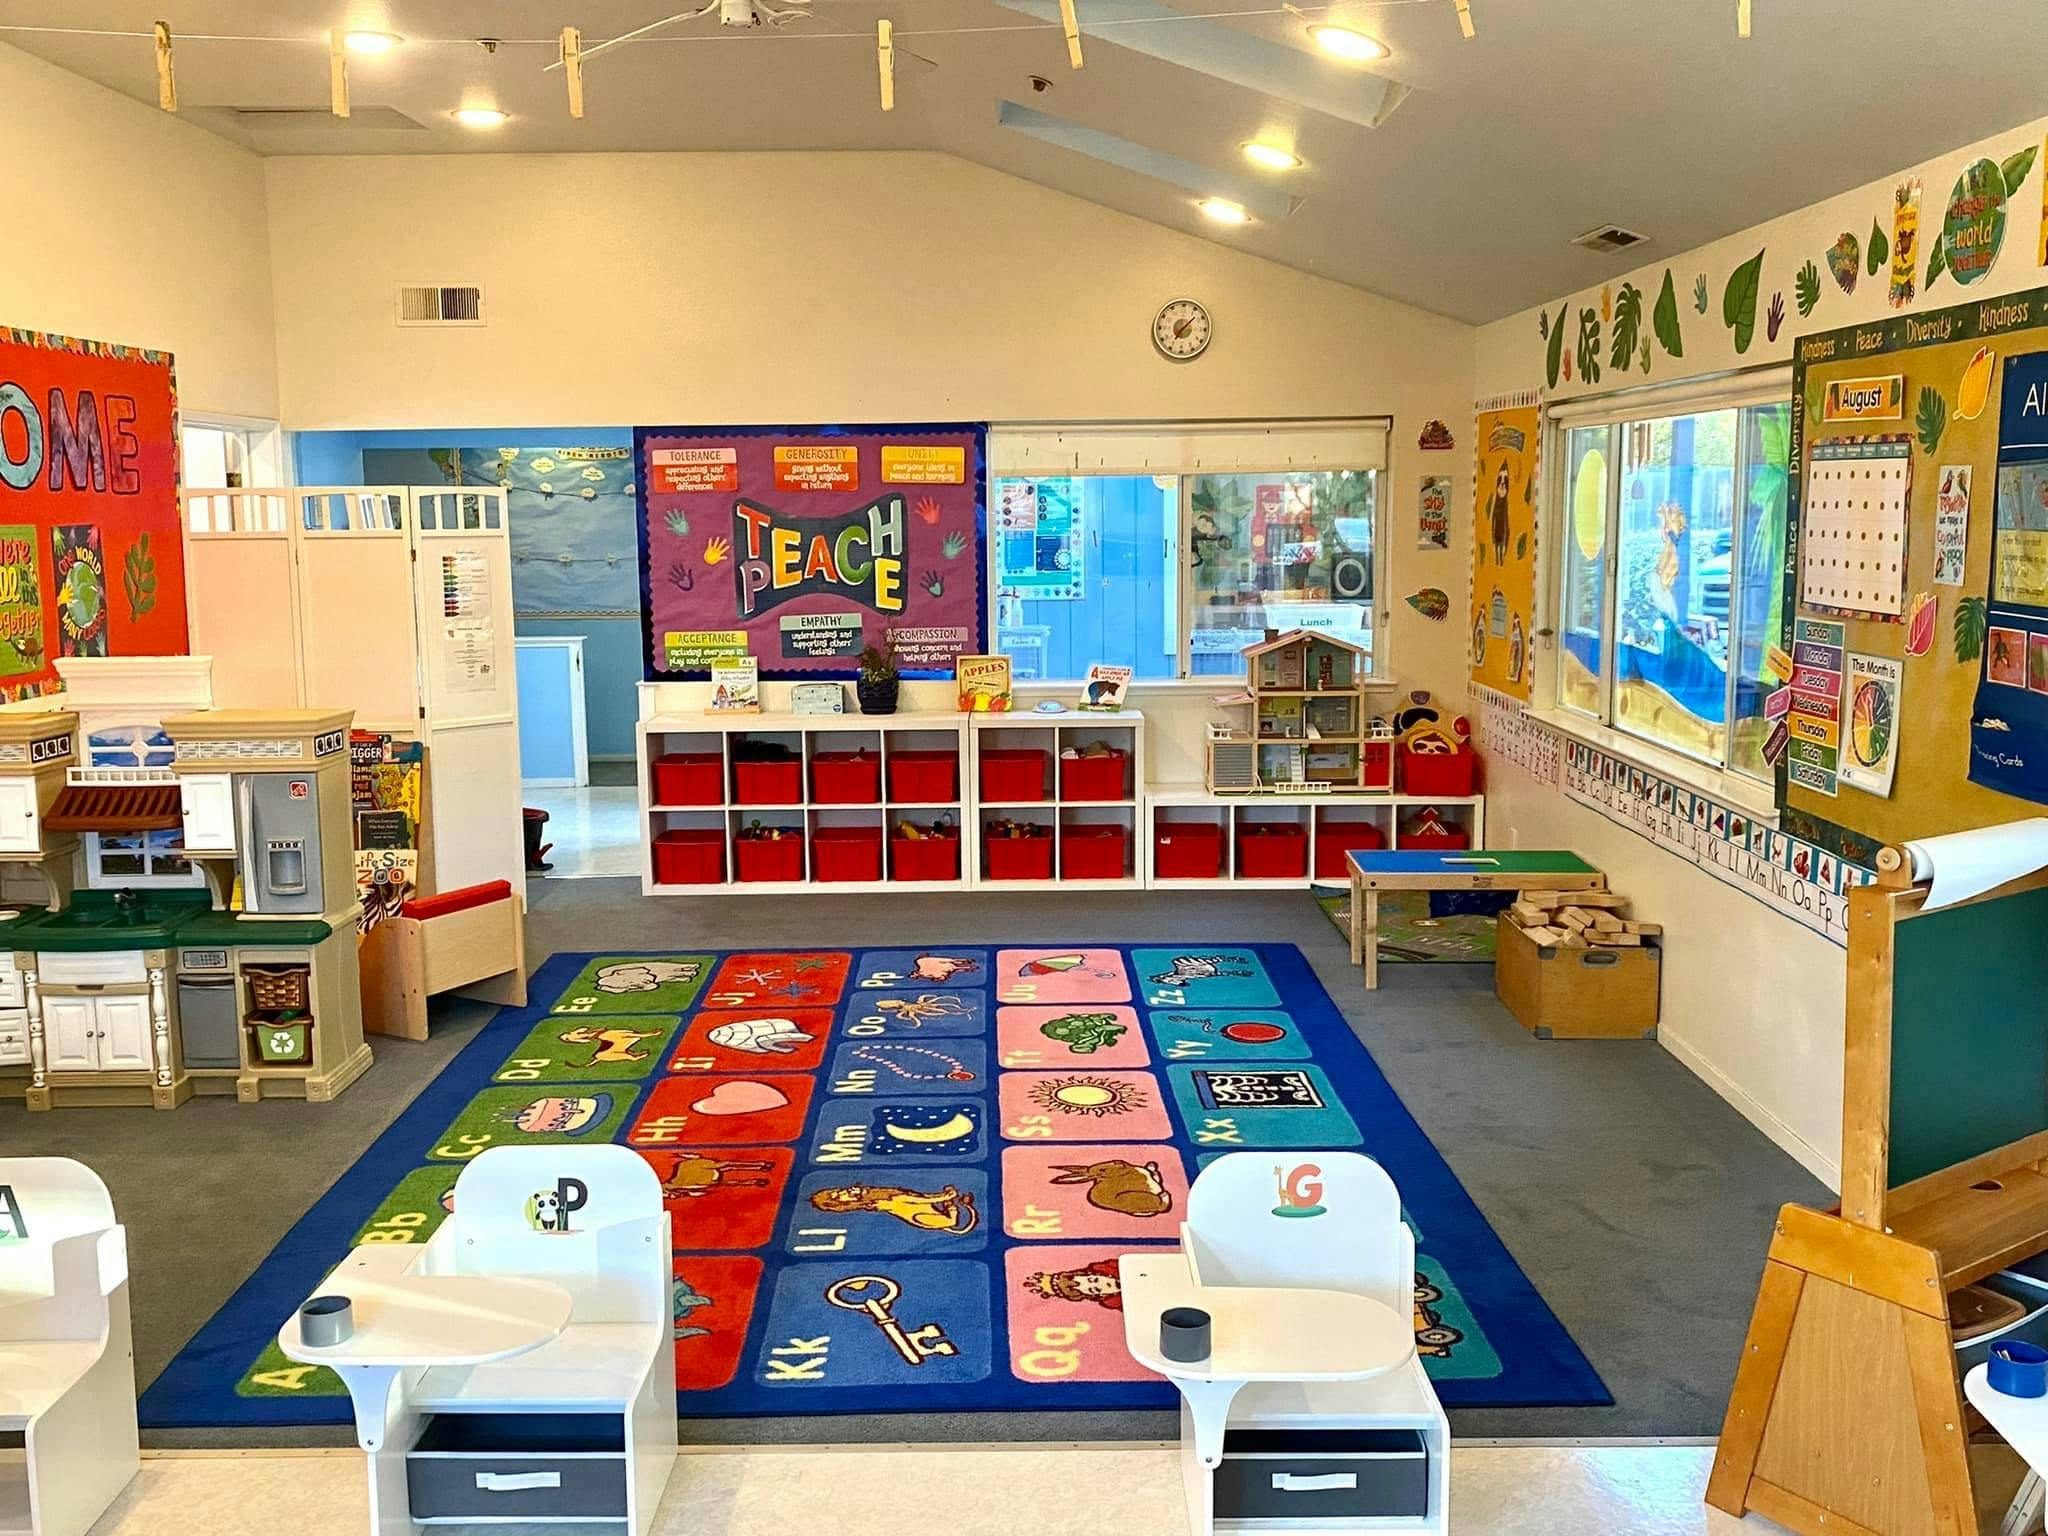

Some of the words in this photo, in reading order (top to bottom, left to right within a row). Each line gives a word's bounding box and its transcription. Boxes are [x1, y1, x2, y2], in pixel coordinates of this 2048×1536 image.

[1956, 217, 1993, 250] world
[1800, 339, 1835, 361] Kindness
[1855, 329, 1884, 352] Peace
[1906, 316, 1952, 344] Diversity
[1979, 302, 2029, 332] Kindness
[1841, 385, 1883, 413] August
[0, 381, 140, 495] OME
[1789, 393, 1803, 475] Diversity
[670, 450, 721, 462] TOLERANCE
[786, 448, 847, 460] GENEROSITY
[710, 464, 724, 473] and
[815, 464, 842, 473] without
[819, 472, 849, 482] anything
[801, 482, 809, 490] in
[810, 481, 832, 490] return
[737, 500, 903, 590] TEACH
[1785, 519, 1798, 575] Peace
[75, 545, 102, 576] WORLD
[739, 526, 903, 614] PEACE
[0, 566, 21, 604] ll
[801, 616, 842, 628] EMPATHY
[1300, 618, 1333, 627] Lunch
[1806, 624, 1831, 641] Sunday
[678, 633, 737, 644] ACCEPTANCE
[840, 630, 853, 639] and
[898, 629, 957, 640] COMPASSION
[703, 648, 735, 657] everyone
[903, 653, 928, 663] helping
[929, 652, 951, 661] others
[949, 643, 962, 651] and
[1803, 647, 1832, 668] Monday
[669, 657, 685, 668] play
[686, 657, 699, 665] and
[963, 661, 1006, 679] APPLES
[1091, 666, 1099, 679] A
[1852, 658, 1865, 672] The
[1866, 661, 1889, 677] Month
[1801, 671, 1829, 693] Tuesday
[1792, 693, 1831, 716] Wednesday
[1797, 718, 1828, 741] Thursday
[352, 747, 382, 758] IGGER
[1801, 742, 1823, 765] Friday
[1999, 752, 2024, 767] Cards
[1797, 765, 1826, 789] Saturday
[355, 851, 415, 869] ife-Size
[1645, 805, 1656, 840] Gg
[1708, 834, 1720, 862] Kk
[1748, 856, 1767, 887] Mm
[1772, 867, 1788, 899] Nn
[1792, 879, 1811, 911] Oo
[1818, 890, 1832, 933] Pp
[863, 972, 904, 988] Pp
[725, 992, 753, 1005] Jj
[1003, 983, 1039, 1002] Uu
[1150, 989, 1186, 1004] Zz
[554, 997, 599, 1013] Ee
[849, 1016, 886, 1036] Oo
[1003, 1049, 1042, 1067] Tt
[1168, 1040, 1213, 1058] Yy
[499, 1059, 551, 1080] Dd
[674, 1057, 715, 1070] Ii
[834, 1070, 875, 1093] Nn
[636, 1116, 687, 1142] Hh
[1007, 1115, 1052, 1138] Ss
[1199, 1118, 1243, 1143] Xx
[436, 1134, 492, 1159] Cc
[817, 1124, 868, 1162] Mm
[1285, 1164, 1322, 1208] G
[557, 1177, 588, 1231] P
[361, 1211, 426, 1244] Bb
[1013, 1203, 1063, 1233] Rr
[795, 1227, 845, 1253] Ll
[766, 1335, 829, 1381] Kk
[1021, 1321, 1091, 1378] Qq
[252, 1364, 317, 1389] A
